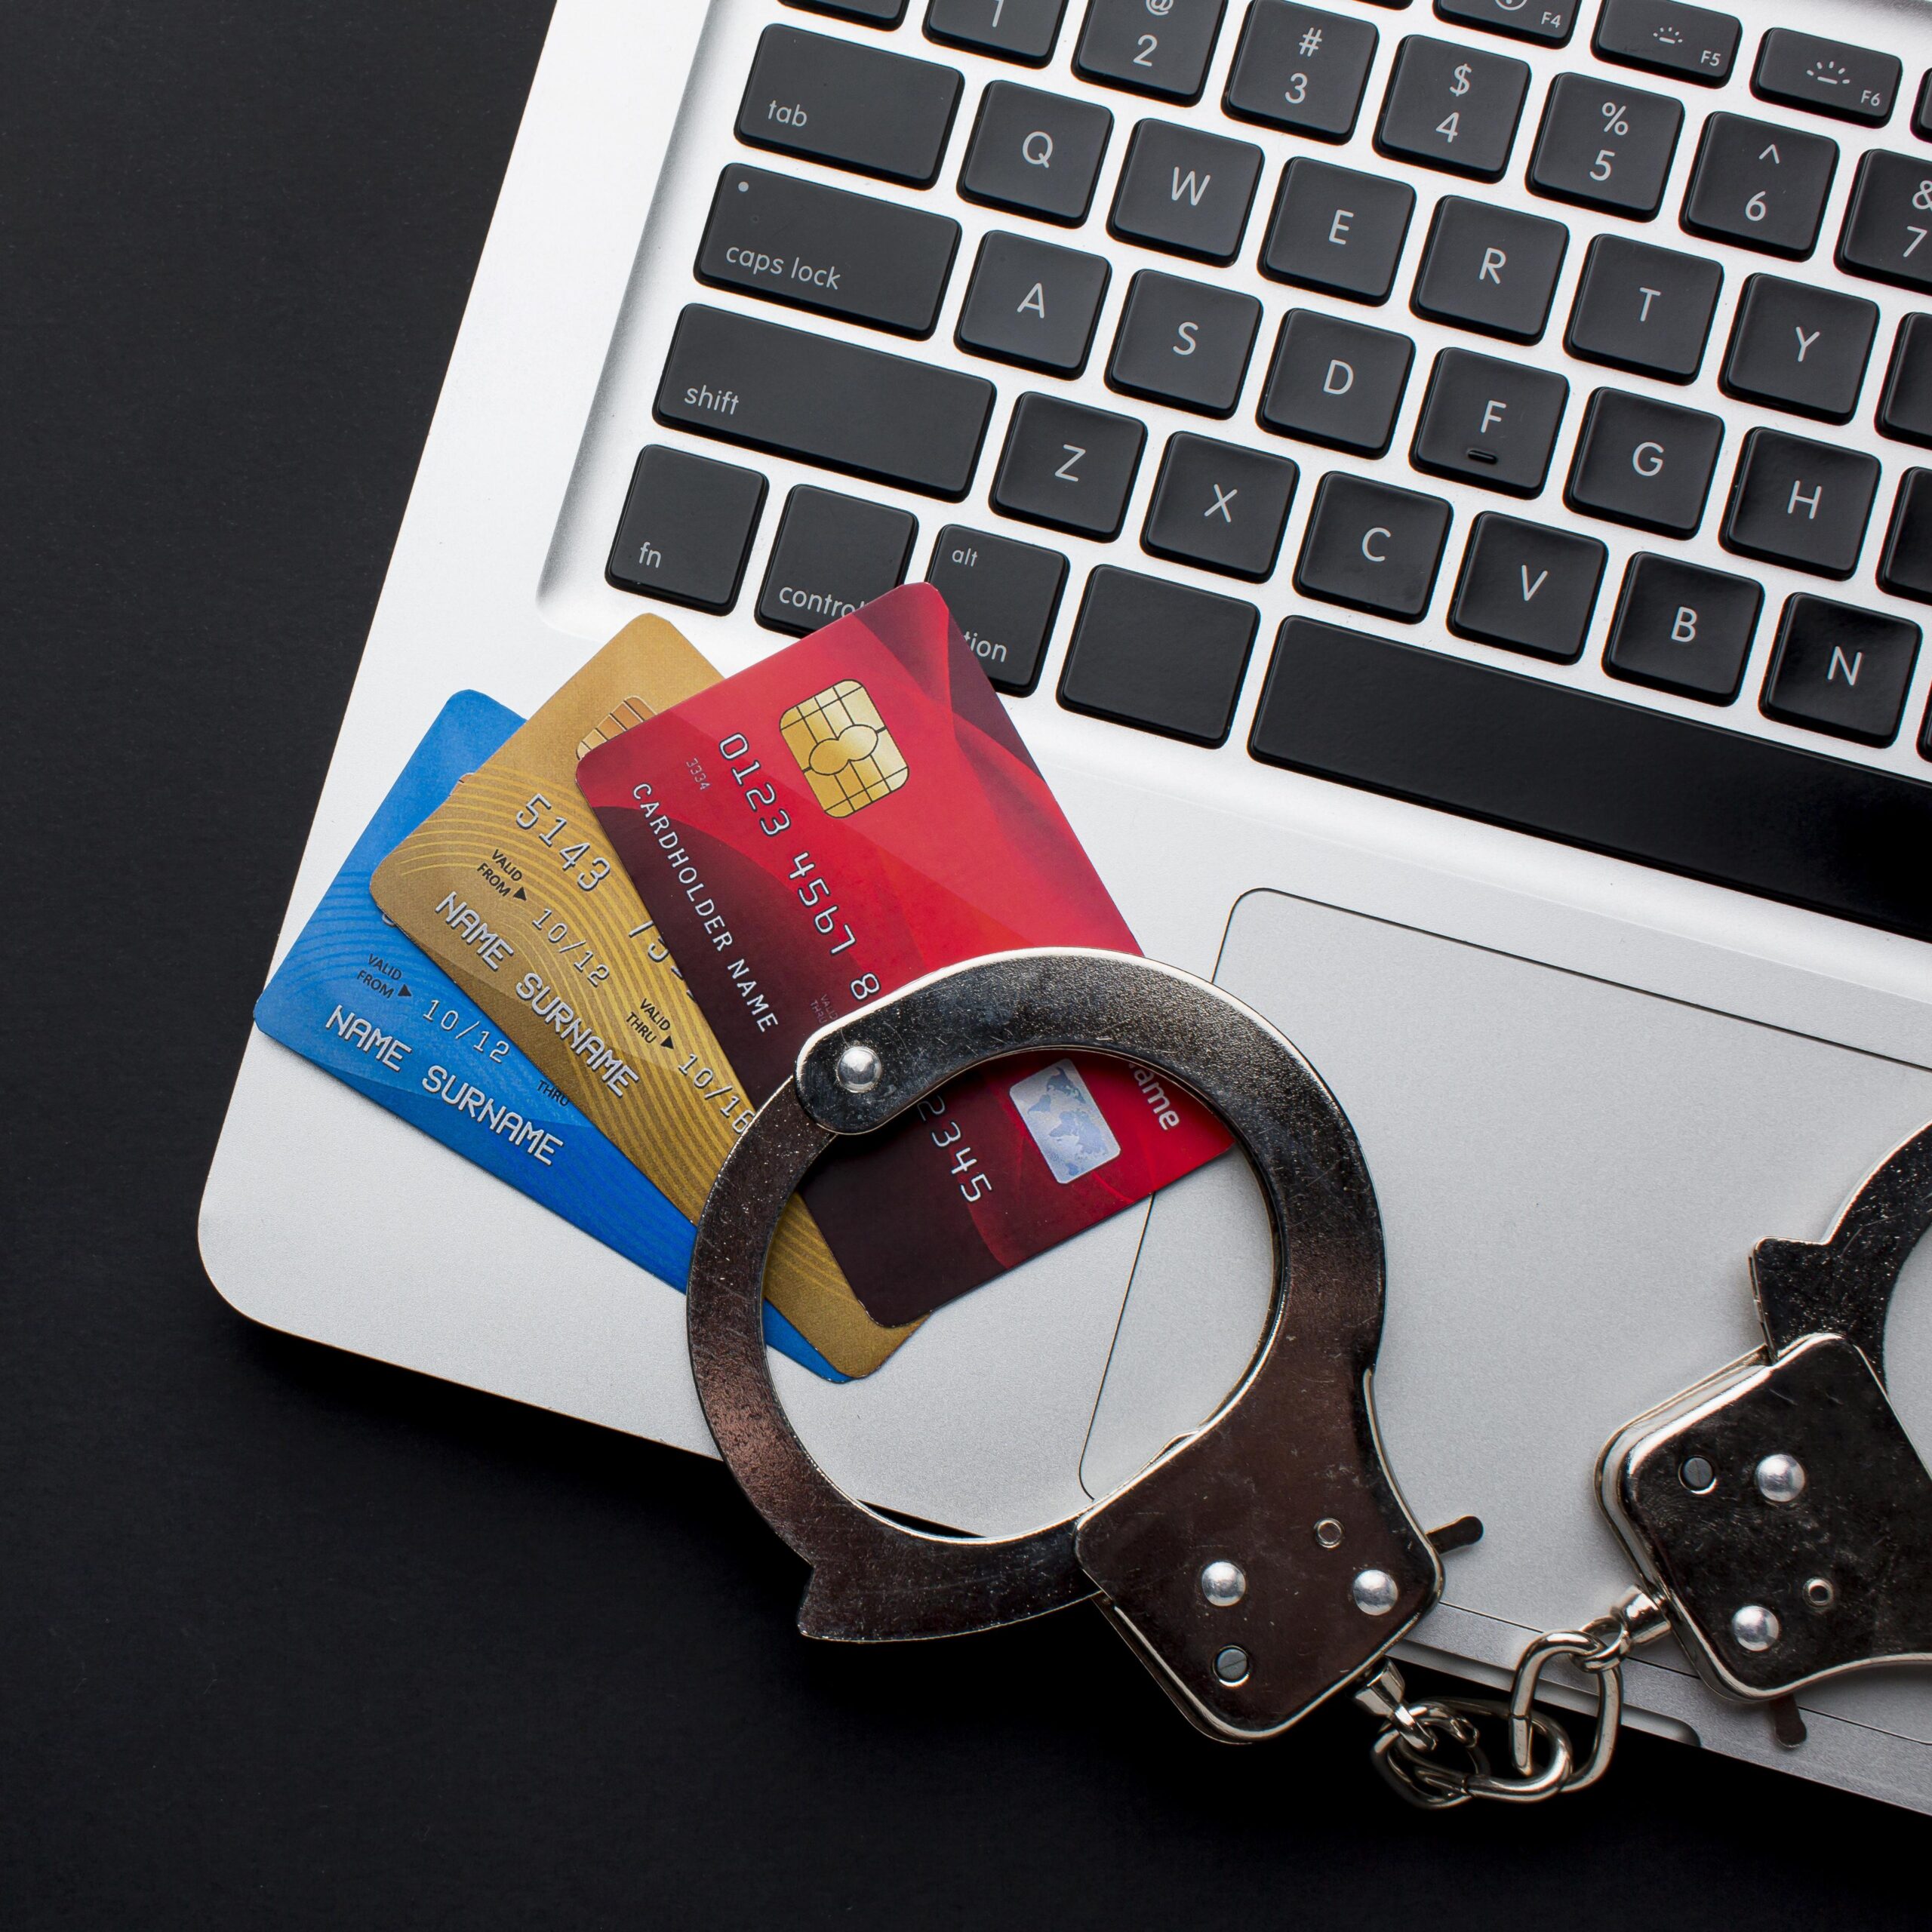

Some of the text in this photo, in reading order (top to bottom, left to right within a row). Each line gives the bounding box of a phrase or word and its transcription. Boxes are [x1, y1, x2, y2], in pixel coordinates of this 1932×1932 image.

[1540, 11, 1561, 29] F4
[1133, 34, 1158, 67] 2
[1298, 27, 1323, 57] #
[1700, 50, 1721, 66] F5
[1284, 72, 1308, 104] 3
[1449, 63, 1472, 97] $
[768, 100, 808, 127] tab
[1860, 89, 1881, 107] F6
[1435, 112, 1460, 143] 4
[1601, 102, 1629, 136] %
[1022, 131, 1054, 168] Q
[1589, 149, 1616, 181] 5
[1171, 166, 1211, 206] W
[1912, 180, 1932, 211] &
[1745, 190, 1767, 222] 6
[1328, 209, 1354, 245] E
[1903, 226, 1927, 257] 7
[726, 247, 841, 291] caps lock
[1478, 247, 1506, 285] R
[1017, 282, 1045, 319] A
[1639, 287, 1661, 322] T
[1173, 321, 1198, 355] S
[1795, 326, 1820, 362] Y
[1323, 359, 1354, 395] D
[684, 384, 740, 415] shift
[1480, 400, 1507, 433] F
[1054, 444, 1086, 482] Z
[1632, 441, 1664, 477] G
[1204, 484, 1238, 523] X
[1787, 480, 1823, 520] H
[638, 541, 662, 568] fn
[952, 548, 978, 567] alt
[1361, 527, 1392, 562] C
[1521, 565, 1549, 601] V
[779, 586, 865, 617] contro
[1671, 606, 1697, 643] B
[1827, 646, 1863, 686] N
[686, 758, 712, 791] 3334
[515, 792, 611, 891] 5143
[718, 732, 791, 836] 0123
[789, 851, 857, 955] 4567
[476, 862, 512, 897] FROM
[491, 848, 523, 882] VALID
[632, 782, 734, 952] CARDHOLDER
[727, 958, 779, 1033] NAME
[531, 908, 611, 988] 10/12
[368, 952, 403, 981] VALID
[356, 970, 395, 999] FROM
[434, 891, 640, 1098] NAME SURNAME
[422, 998, 511, 1063] 10/12
[626, 1011, 657, 1044] THRU
[639, 997, 672, 1032] VALID
[325, 1004, 565, 1166] NAME SURNAME
[537, 1079, 569, 1107] THRU
[678, 1053, 756, 1134] 10/16
[1128, 1063, 1180, 1131] ame
